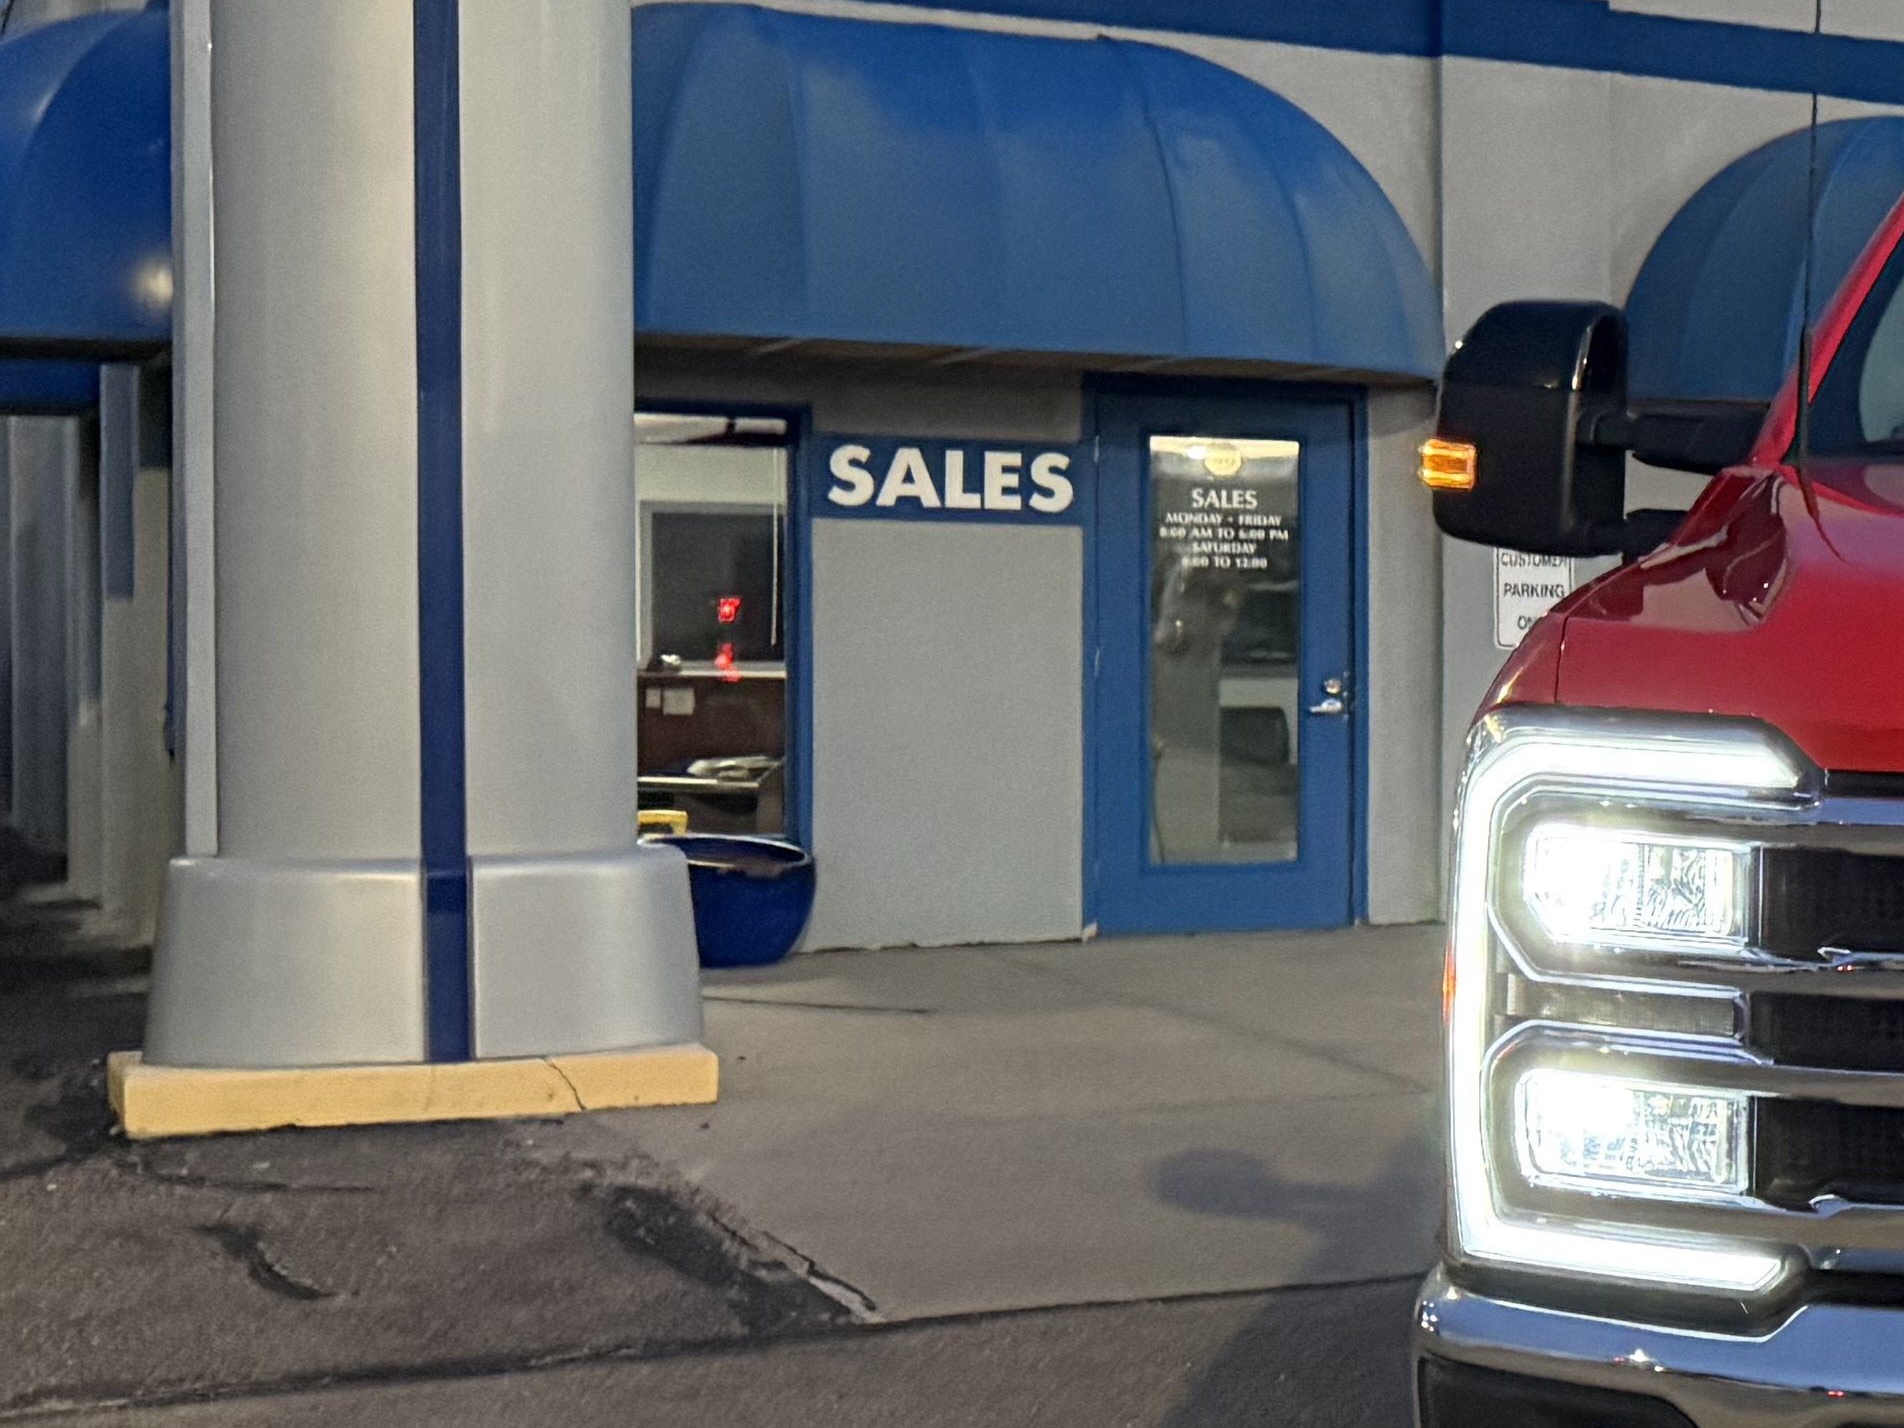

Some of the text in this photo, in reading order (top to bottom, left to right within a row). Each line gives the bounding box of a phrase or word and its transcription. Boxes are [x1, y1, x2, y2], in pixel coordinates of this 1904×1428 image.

[827, 444, 1074, 513] SALES
[1192, 488, 1258, 509] SALES
[1165, 513, 1223, 524] MONDAY
[1238, 515, 1282, 526] FRIDAY
[1191, 528, 1212, 538] AM
[1218, 529, 1234, 539] TO
[1269, 530, 1288, 540] PM
[1192, 542, 1257, 554] SATURDAY
[1214, 557, 1231, 568] TO
[1504, 583, 1564, 598] PARKING
